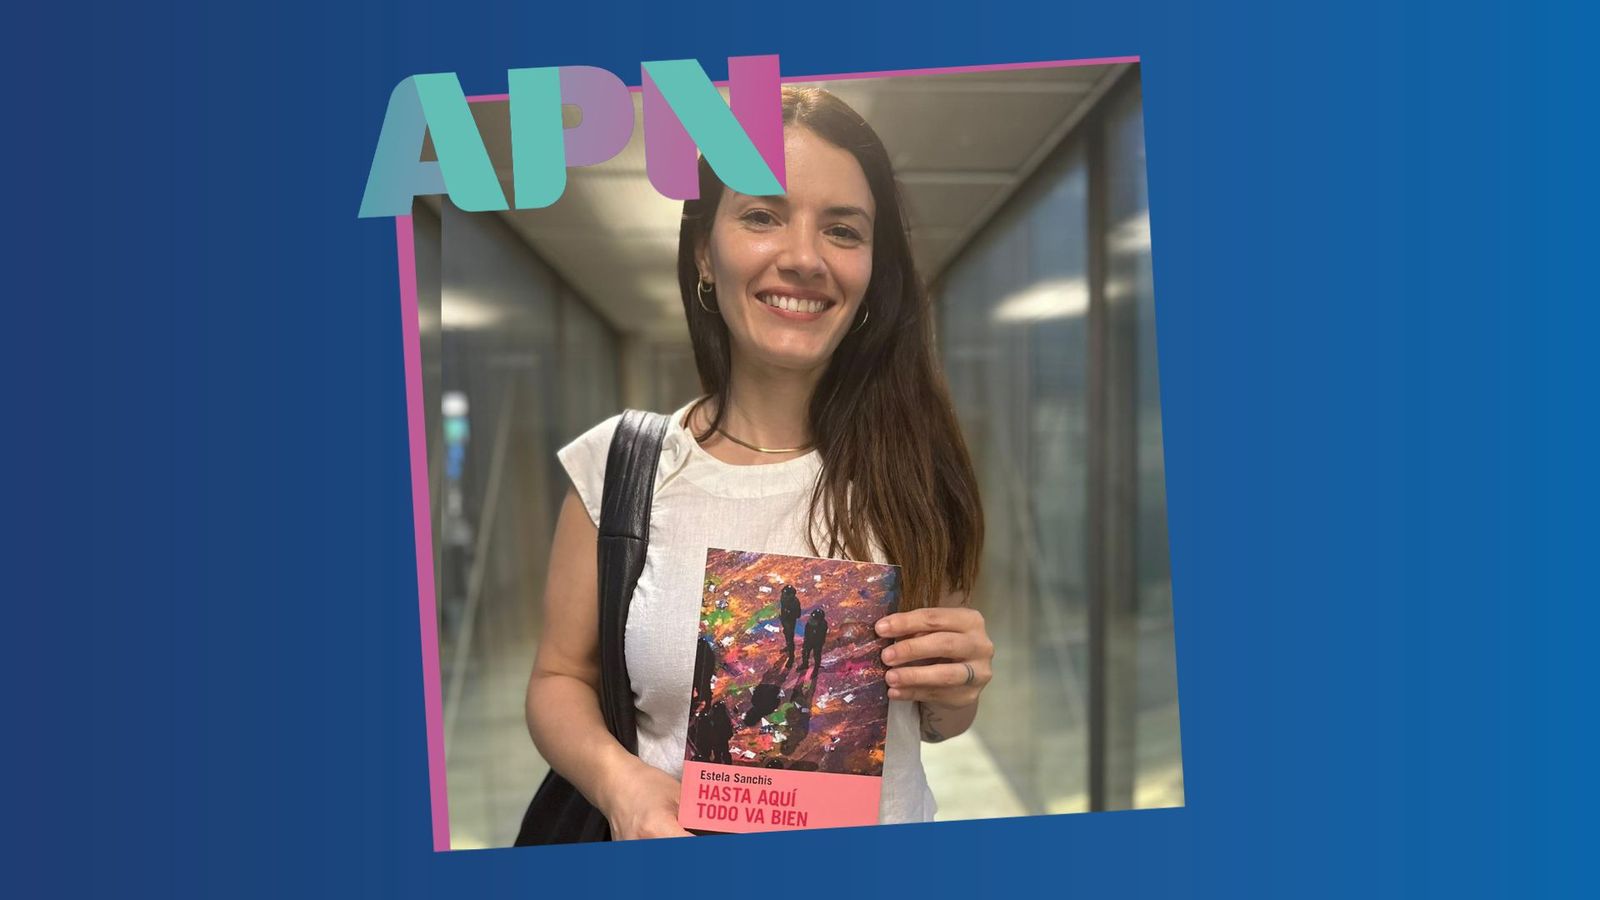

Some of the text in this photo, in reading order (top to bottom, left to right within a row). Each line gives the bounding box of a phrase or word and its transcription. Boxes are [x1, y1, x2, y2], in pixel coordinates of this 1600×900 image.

[700, 770, 773, 786] Estela Sanchis
[698, 784, 798, 807] HASTA AQUÍ
[696, 802, 808, 827] TODO VA BIEN
